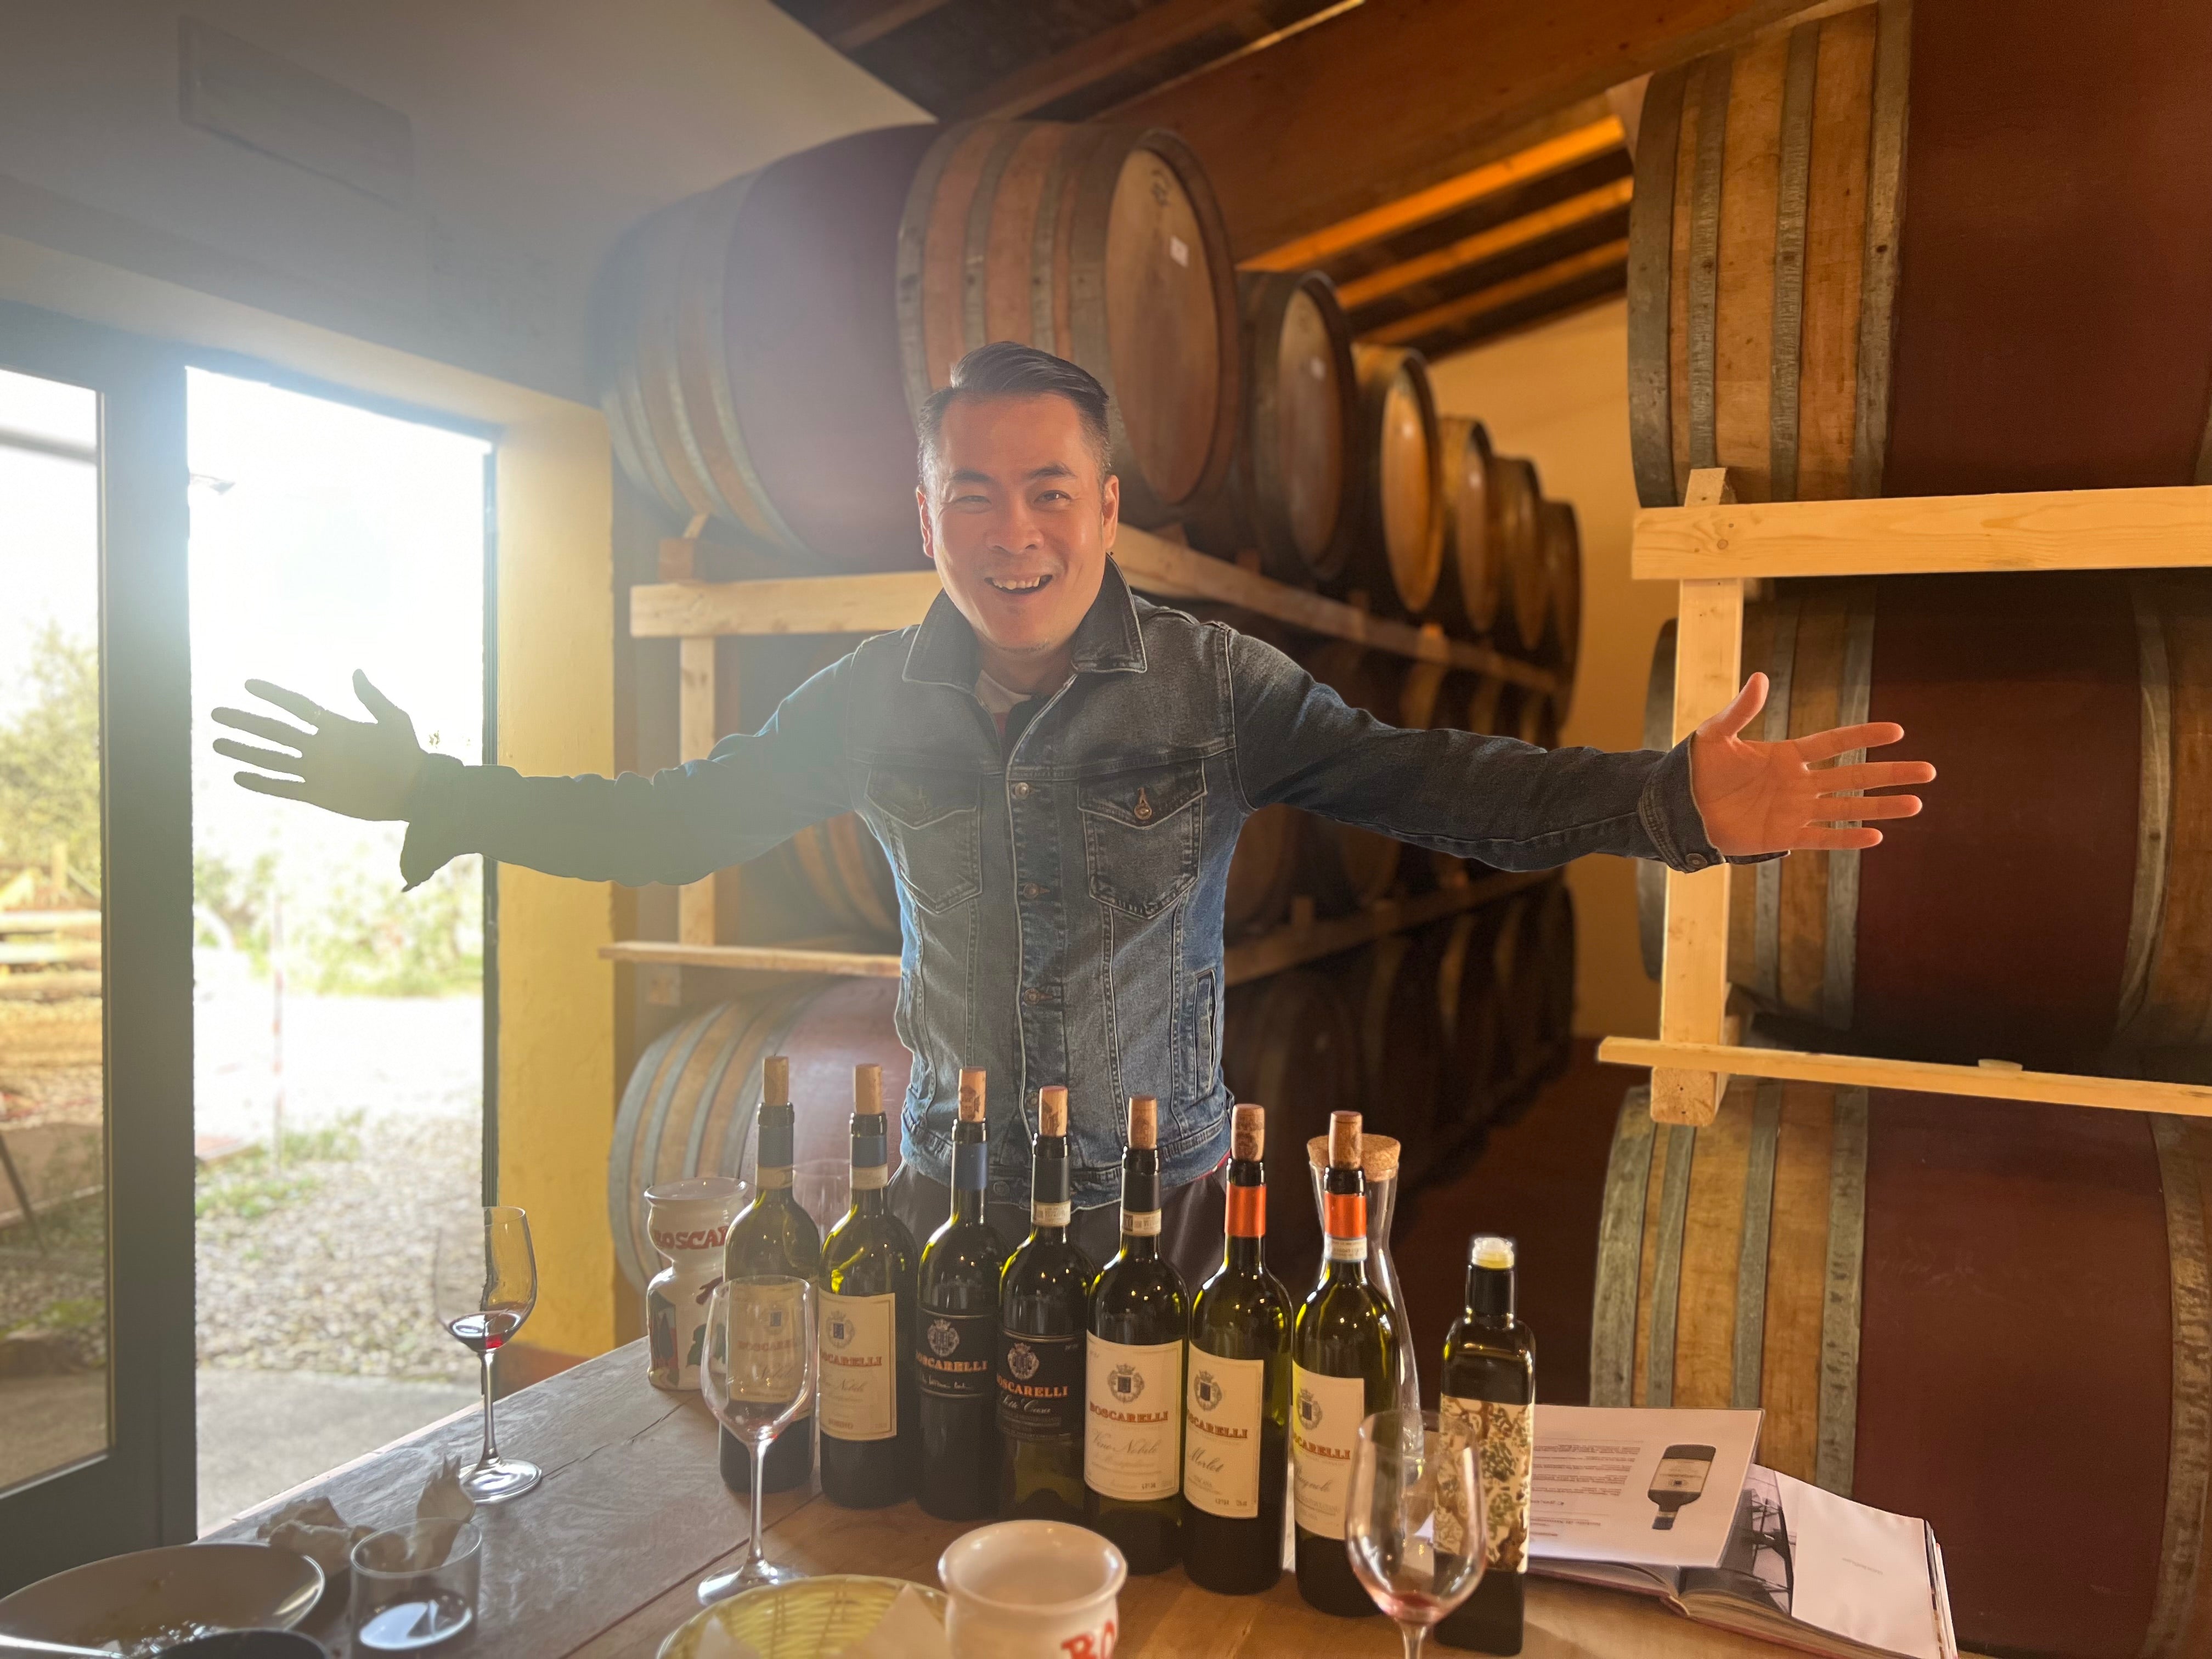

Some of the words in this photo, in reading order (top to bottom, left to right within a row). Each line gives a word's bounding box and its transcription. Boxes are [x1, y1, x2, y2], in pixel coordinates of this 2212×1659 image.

[916, 1351, 988, 1372] OSCARELLI
[996, 1373, 1068, 1398] OSCARELLI
[1090, 1401, 1169, 1423] BOSCARELLI
